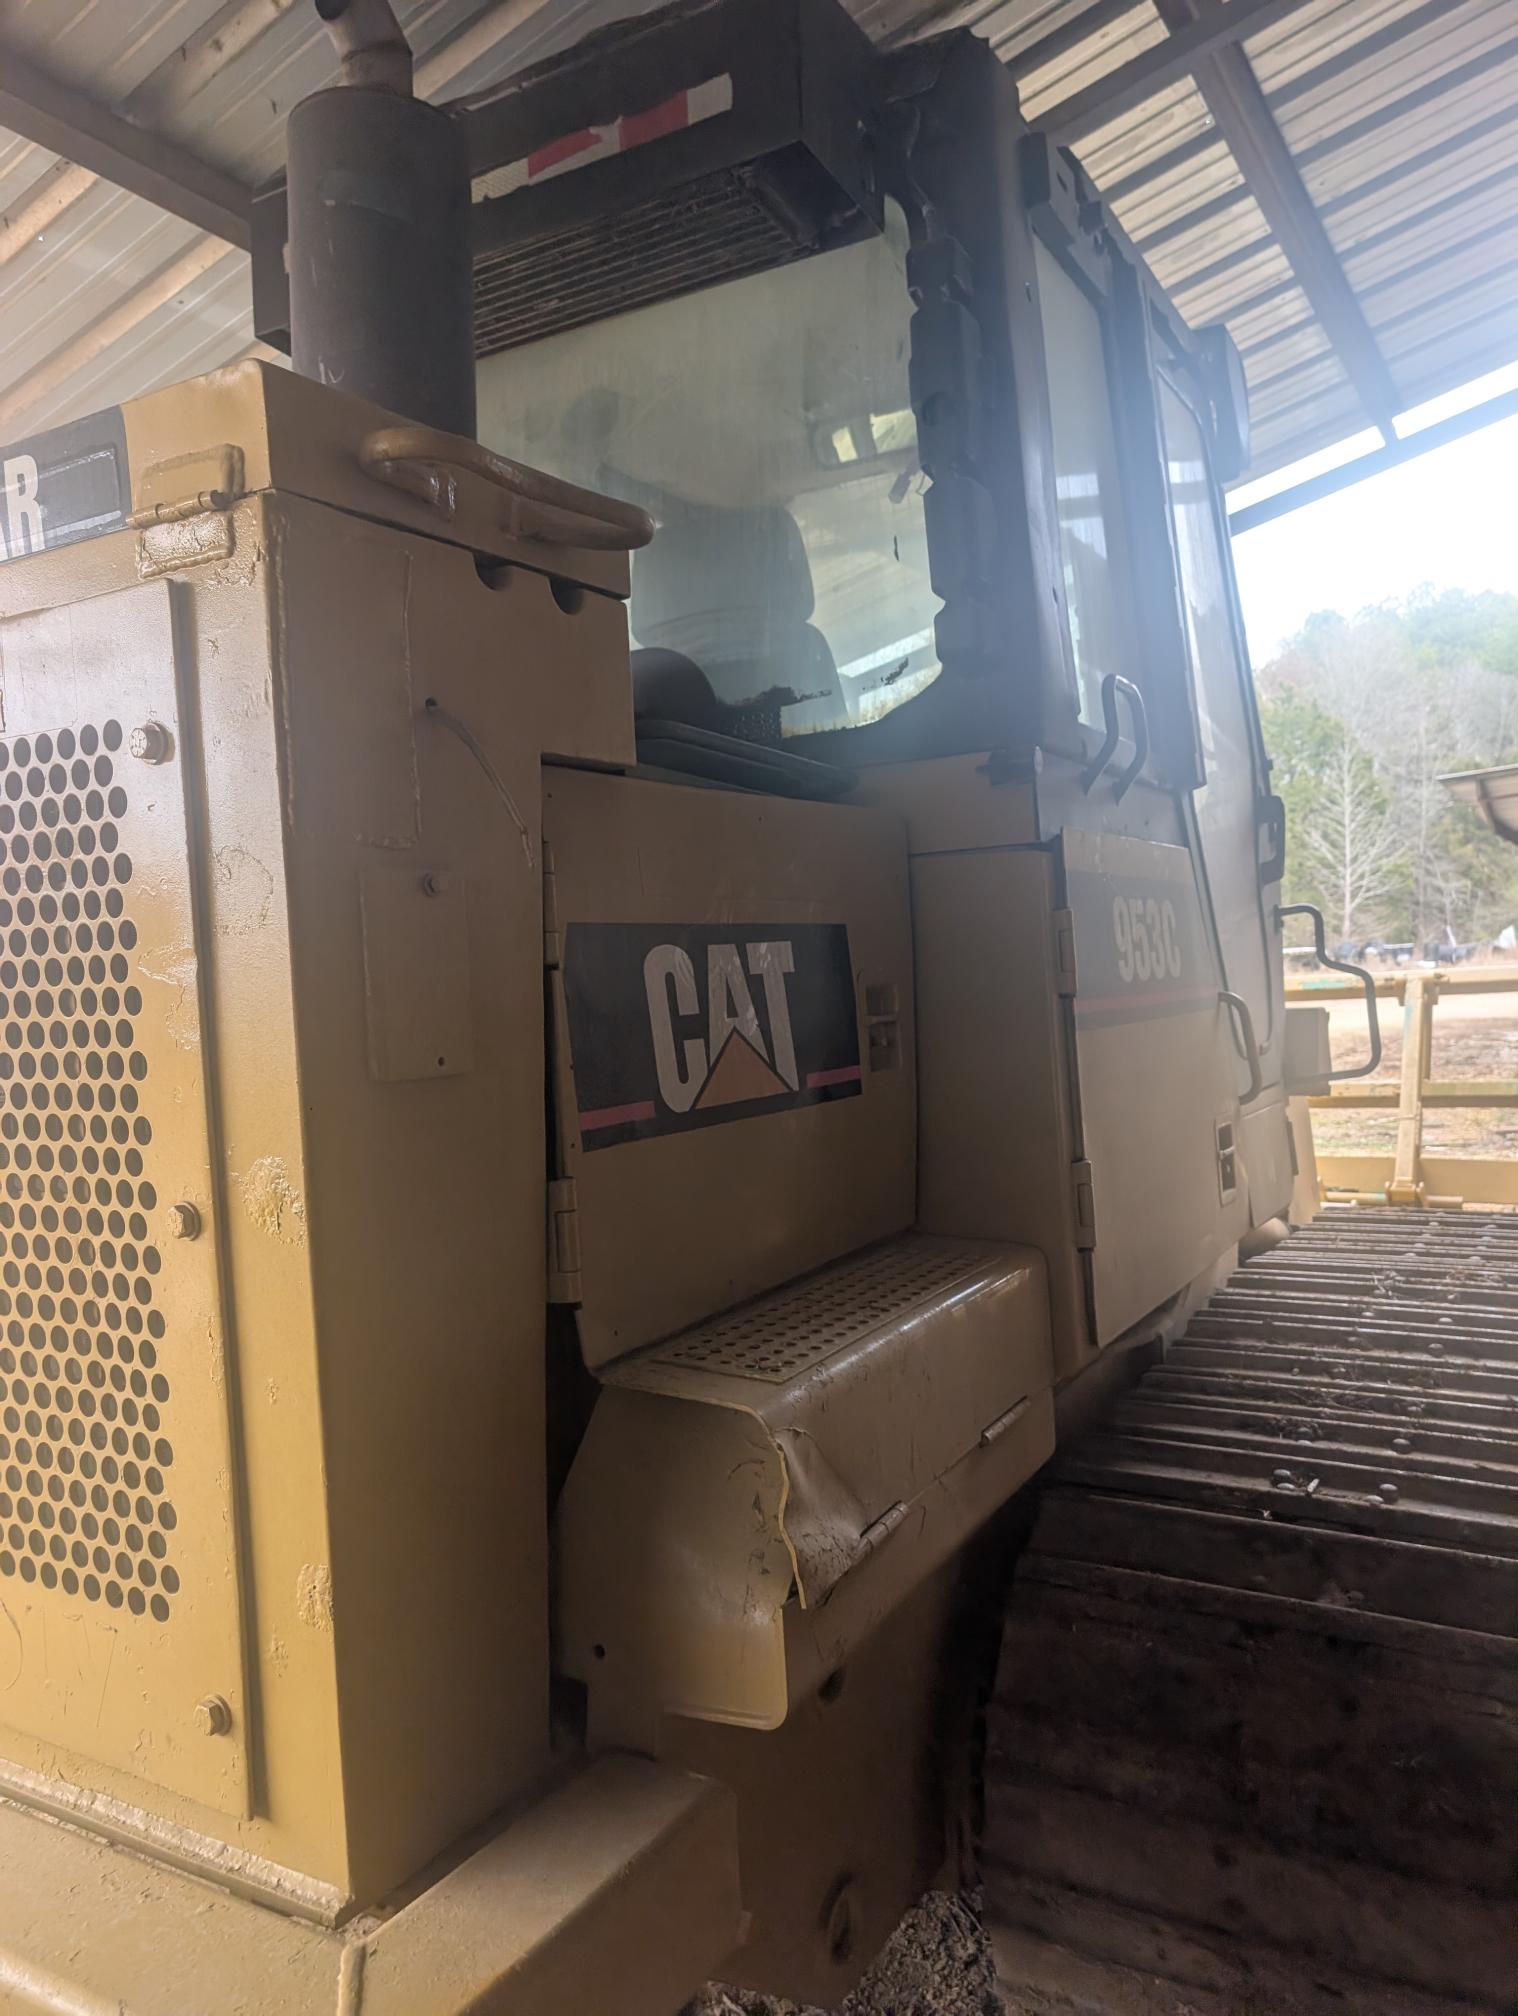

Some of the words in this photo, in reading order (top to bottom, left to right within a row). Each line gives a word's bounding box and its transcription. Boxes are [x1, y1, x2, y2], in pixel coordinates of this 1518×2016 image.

[0, 454, 46, 562] R
[1113, 896, 1181, 982] 953C
[643, 941, 799, 1113] CAT
